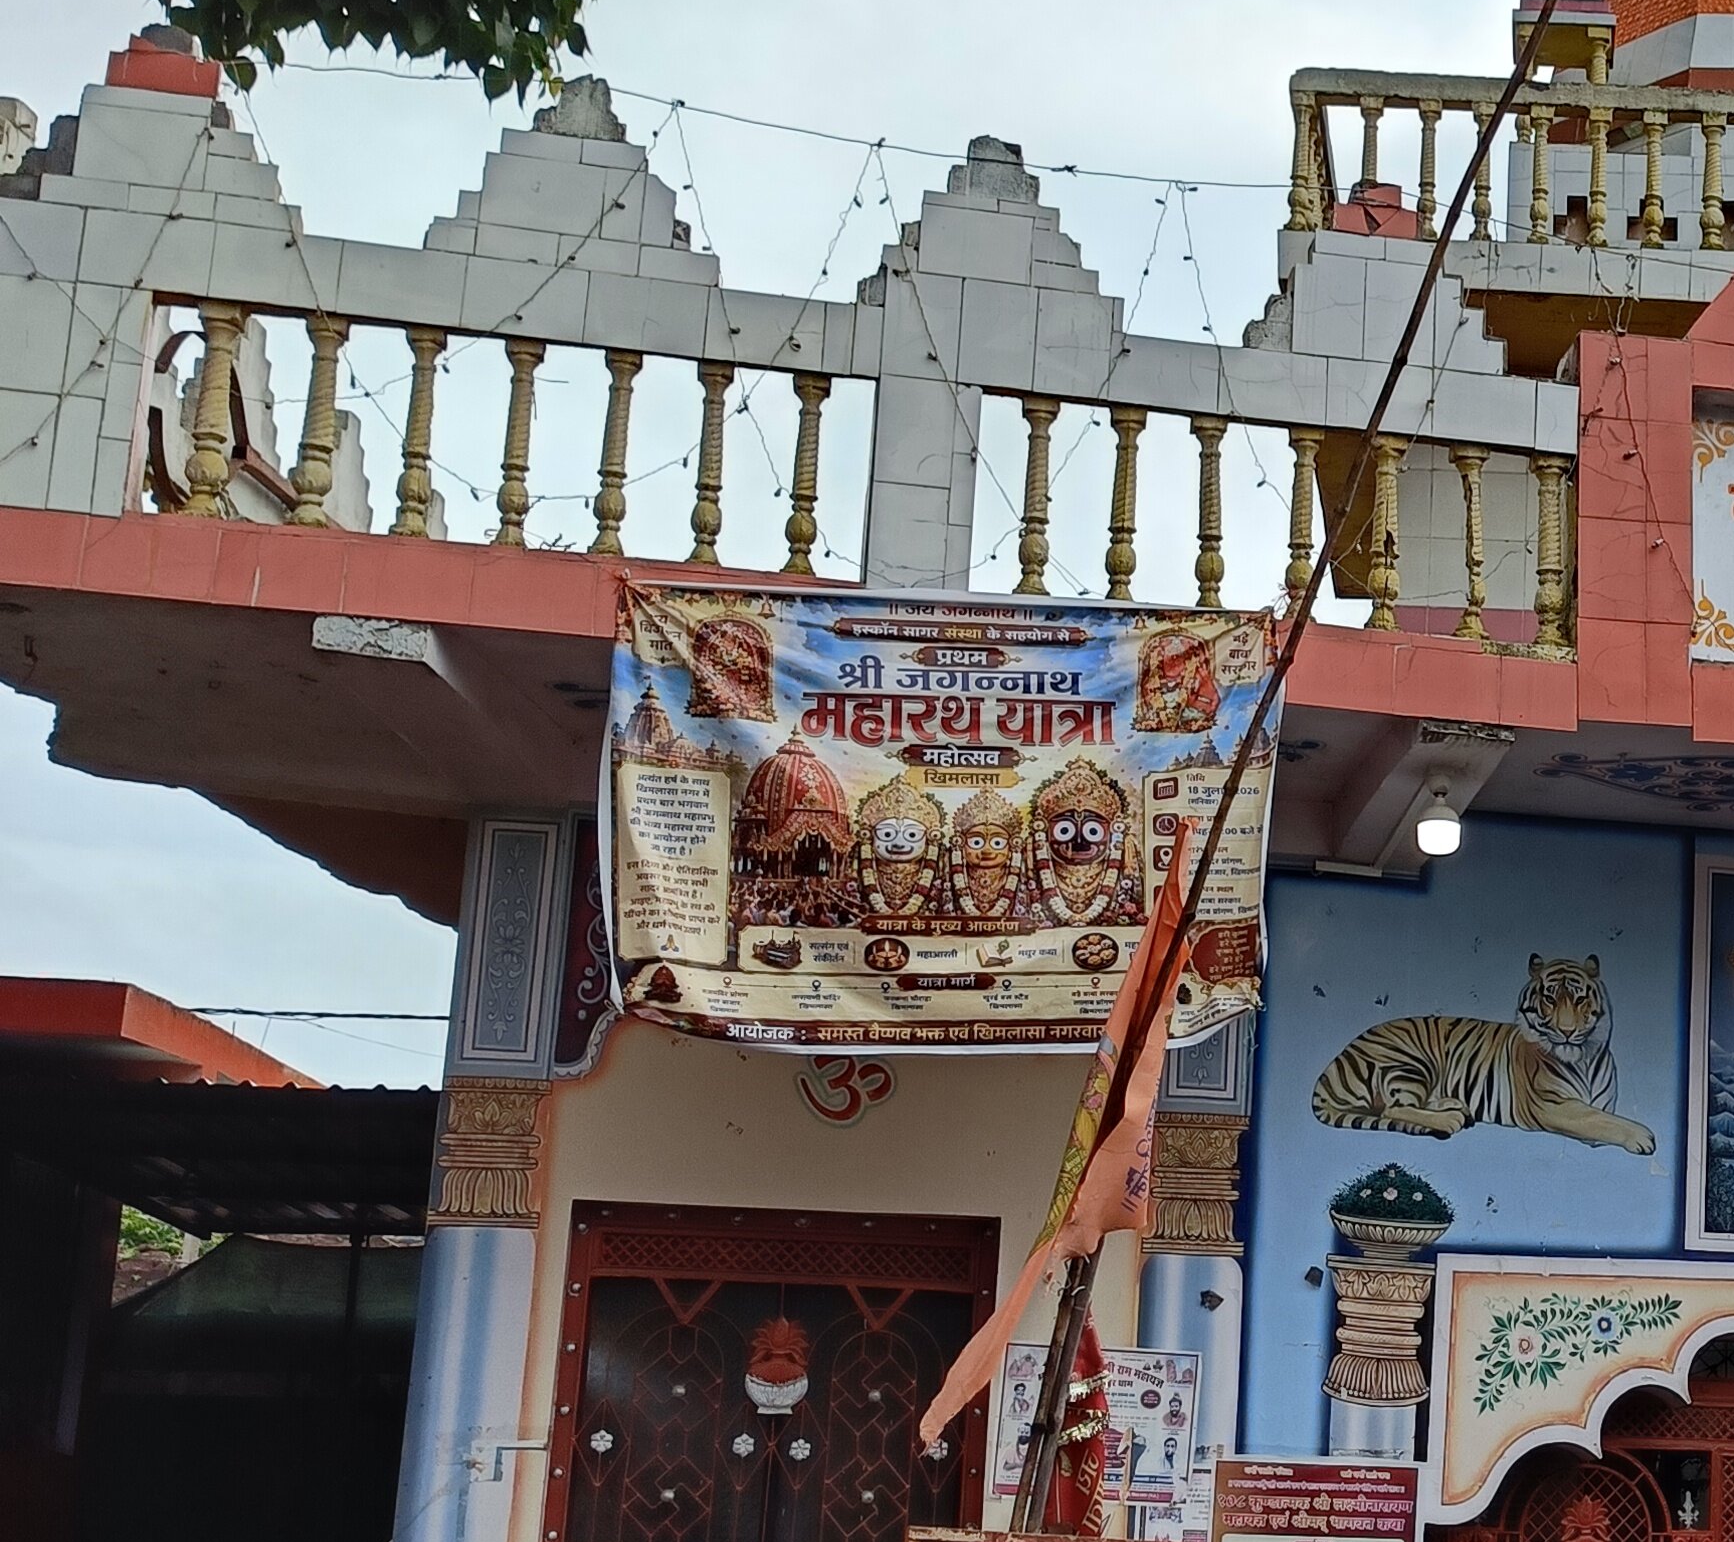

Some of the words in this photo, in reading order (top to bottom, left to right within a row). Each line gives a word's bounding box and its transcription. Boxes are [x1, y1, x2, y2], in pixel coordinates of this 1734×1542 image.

[905, 604, 935, 617] जय
[941, 606, 1016, 620] जगन्नाथ
[852, 622, 898, 638] इस्कॉन
[903, 626, 939, 638] सागर
[944, 624, 982, 640] संस्था
[986, 626, 1000, 640] के
[1006, 629, 1052, 642] सहयोग
[1057, 628, 1070, 642] से
[936, 650, 988, 666] प्रथम
[837, 655, 884, 690] श्री
[896, 667, 1083, 696] जगन्नाथ
[801, 692, 984, 748] महारथ
[996, 697, 1116, 747] यात्रा
[923, 744, 1000, 767] महोत्सव
[924, 769, 1000, 786] खिमलासा
[636, 784, 678, 796] खिमलासा
[681, 789, 700, 797] नगर
[1188, 786, 1199, 794] 18
[1202, 787, 1225, 797] जुला
[877, 920, 907, 931] यात्रा
[912, 917, 926, 931] के
[931, 920, 962, 937] मुख्य
[967, 917, 1019, 933] आकर्षण
[917, 950, 958, 959] महाआरती
[917, 977, 946, 987] यात्रा
[949, 974, 976, 987] मार्ग
[726, 1022, 795, 1041] आयोजक
[818, 1027, 864, 1042] समस्त
[869, 1023, 912, 1041] वैष्णव
[914, 1028, 945, 1041] भक्त
[950, 1023, 969, 1042] एवं
[974, 1023, 1046, 1041] खिमलासा
[1313, 1492, 1330, 1510] श्री
